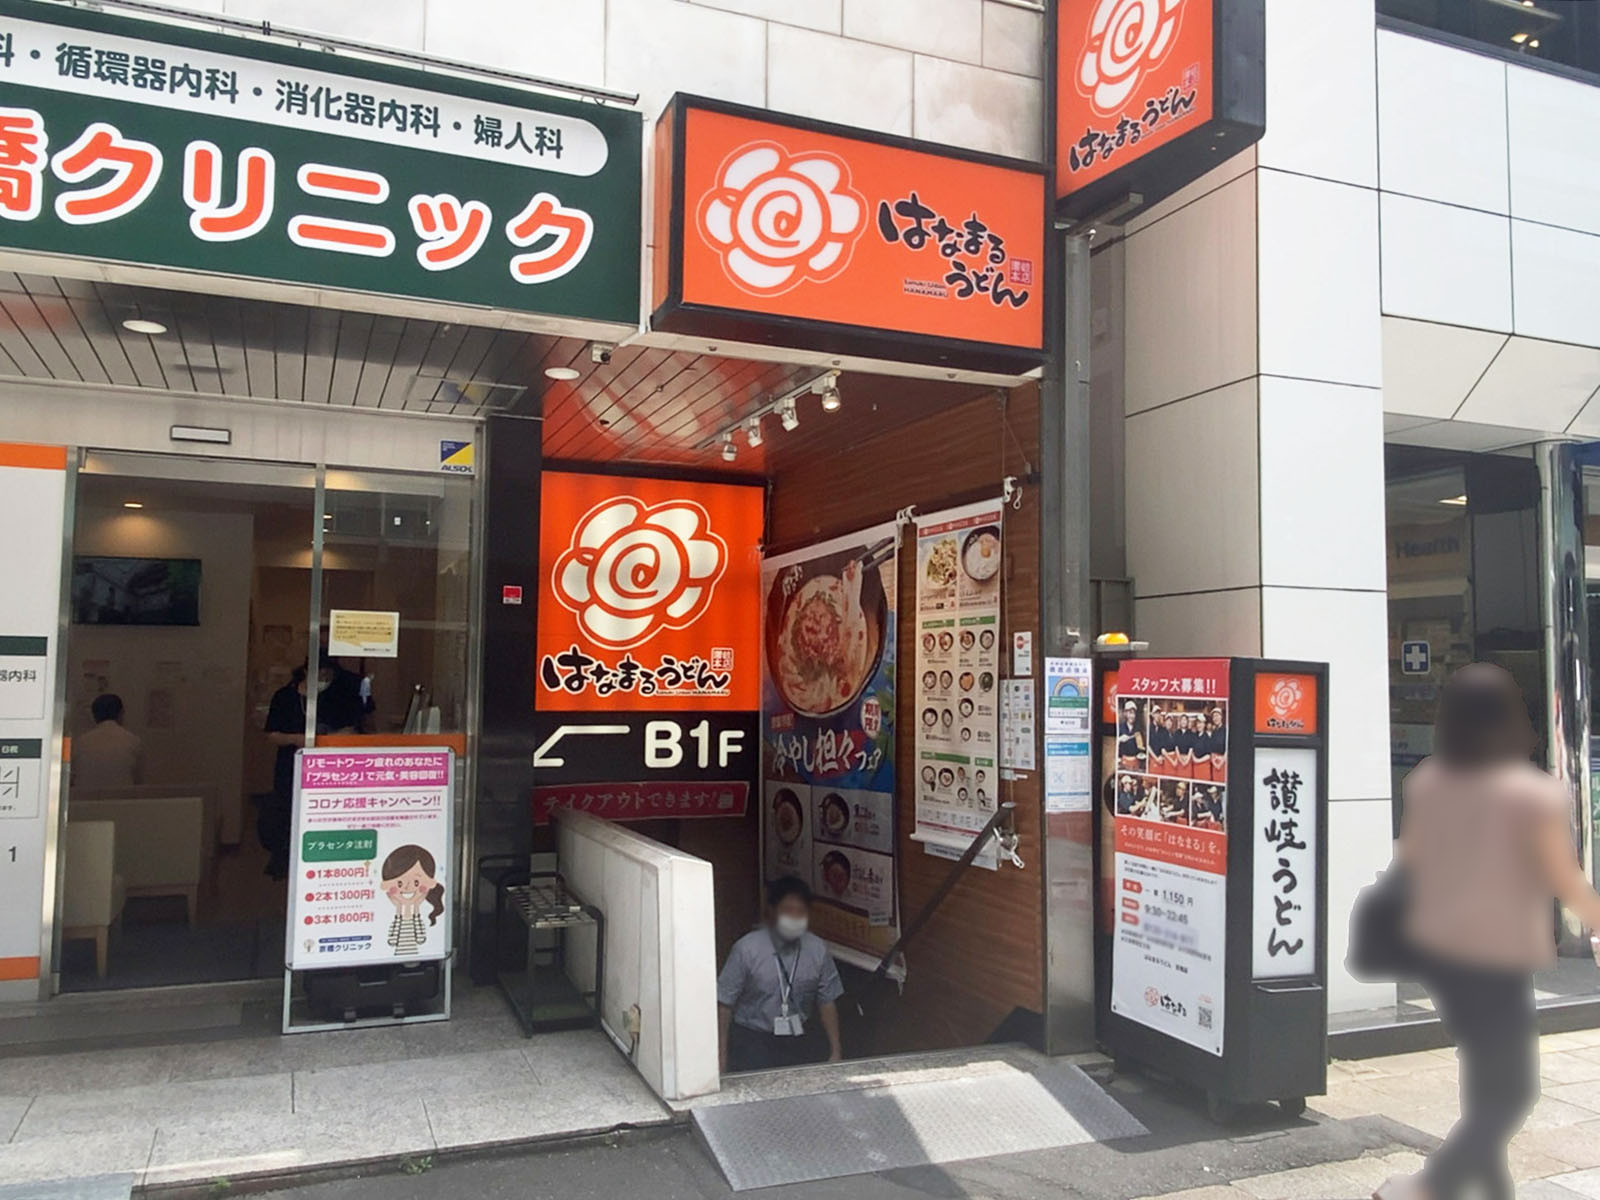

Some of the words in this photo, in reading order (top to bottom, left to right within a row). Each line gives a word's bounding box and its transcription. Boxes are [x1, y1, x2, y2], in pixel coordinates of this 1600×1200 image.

[1069, 87, 1197, 172] はなまるうどん
[877, 191, 1006, 264] はなまる
[944, 260, 1029, 308] うどん
[440, 464, 473, 473] ALSOK
[540, 644, 730, 698] はなまるうどん
[1131, 677, 1217, 694] スタッフ大募集!!
[645, 720, 745, 768] B1F
[1263, 768, 1306, 957] 讃岐うどん
